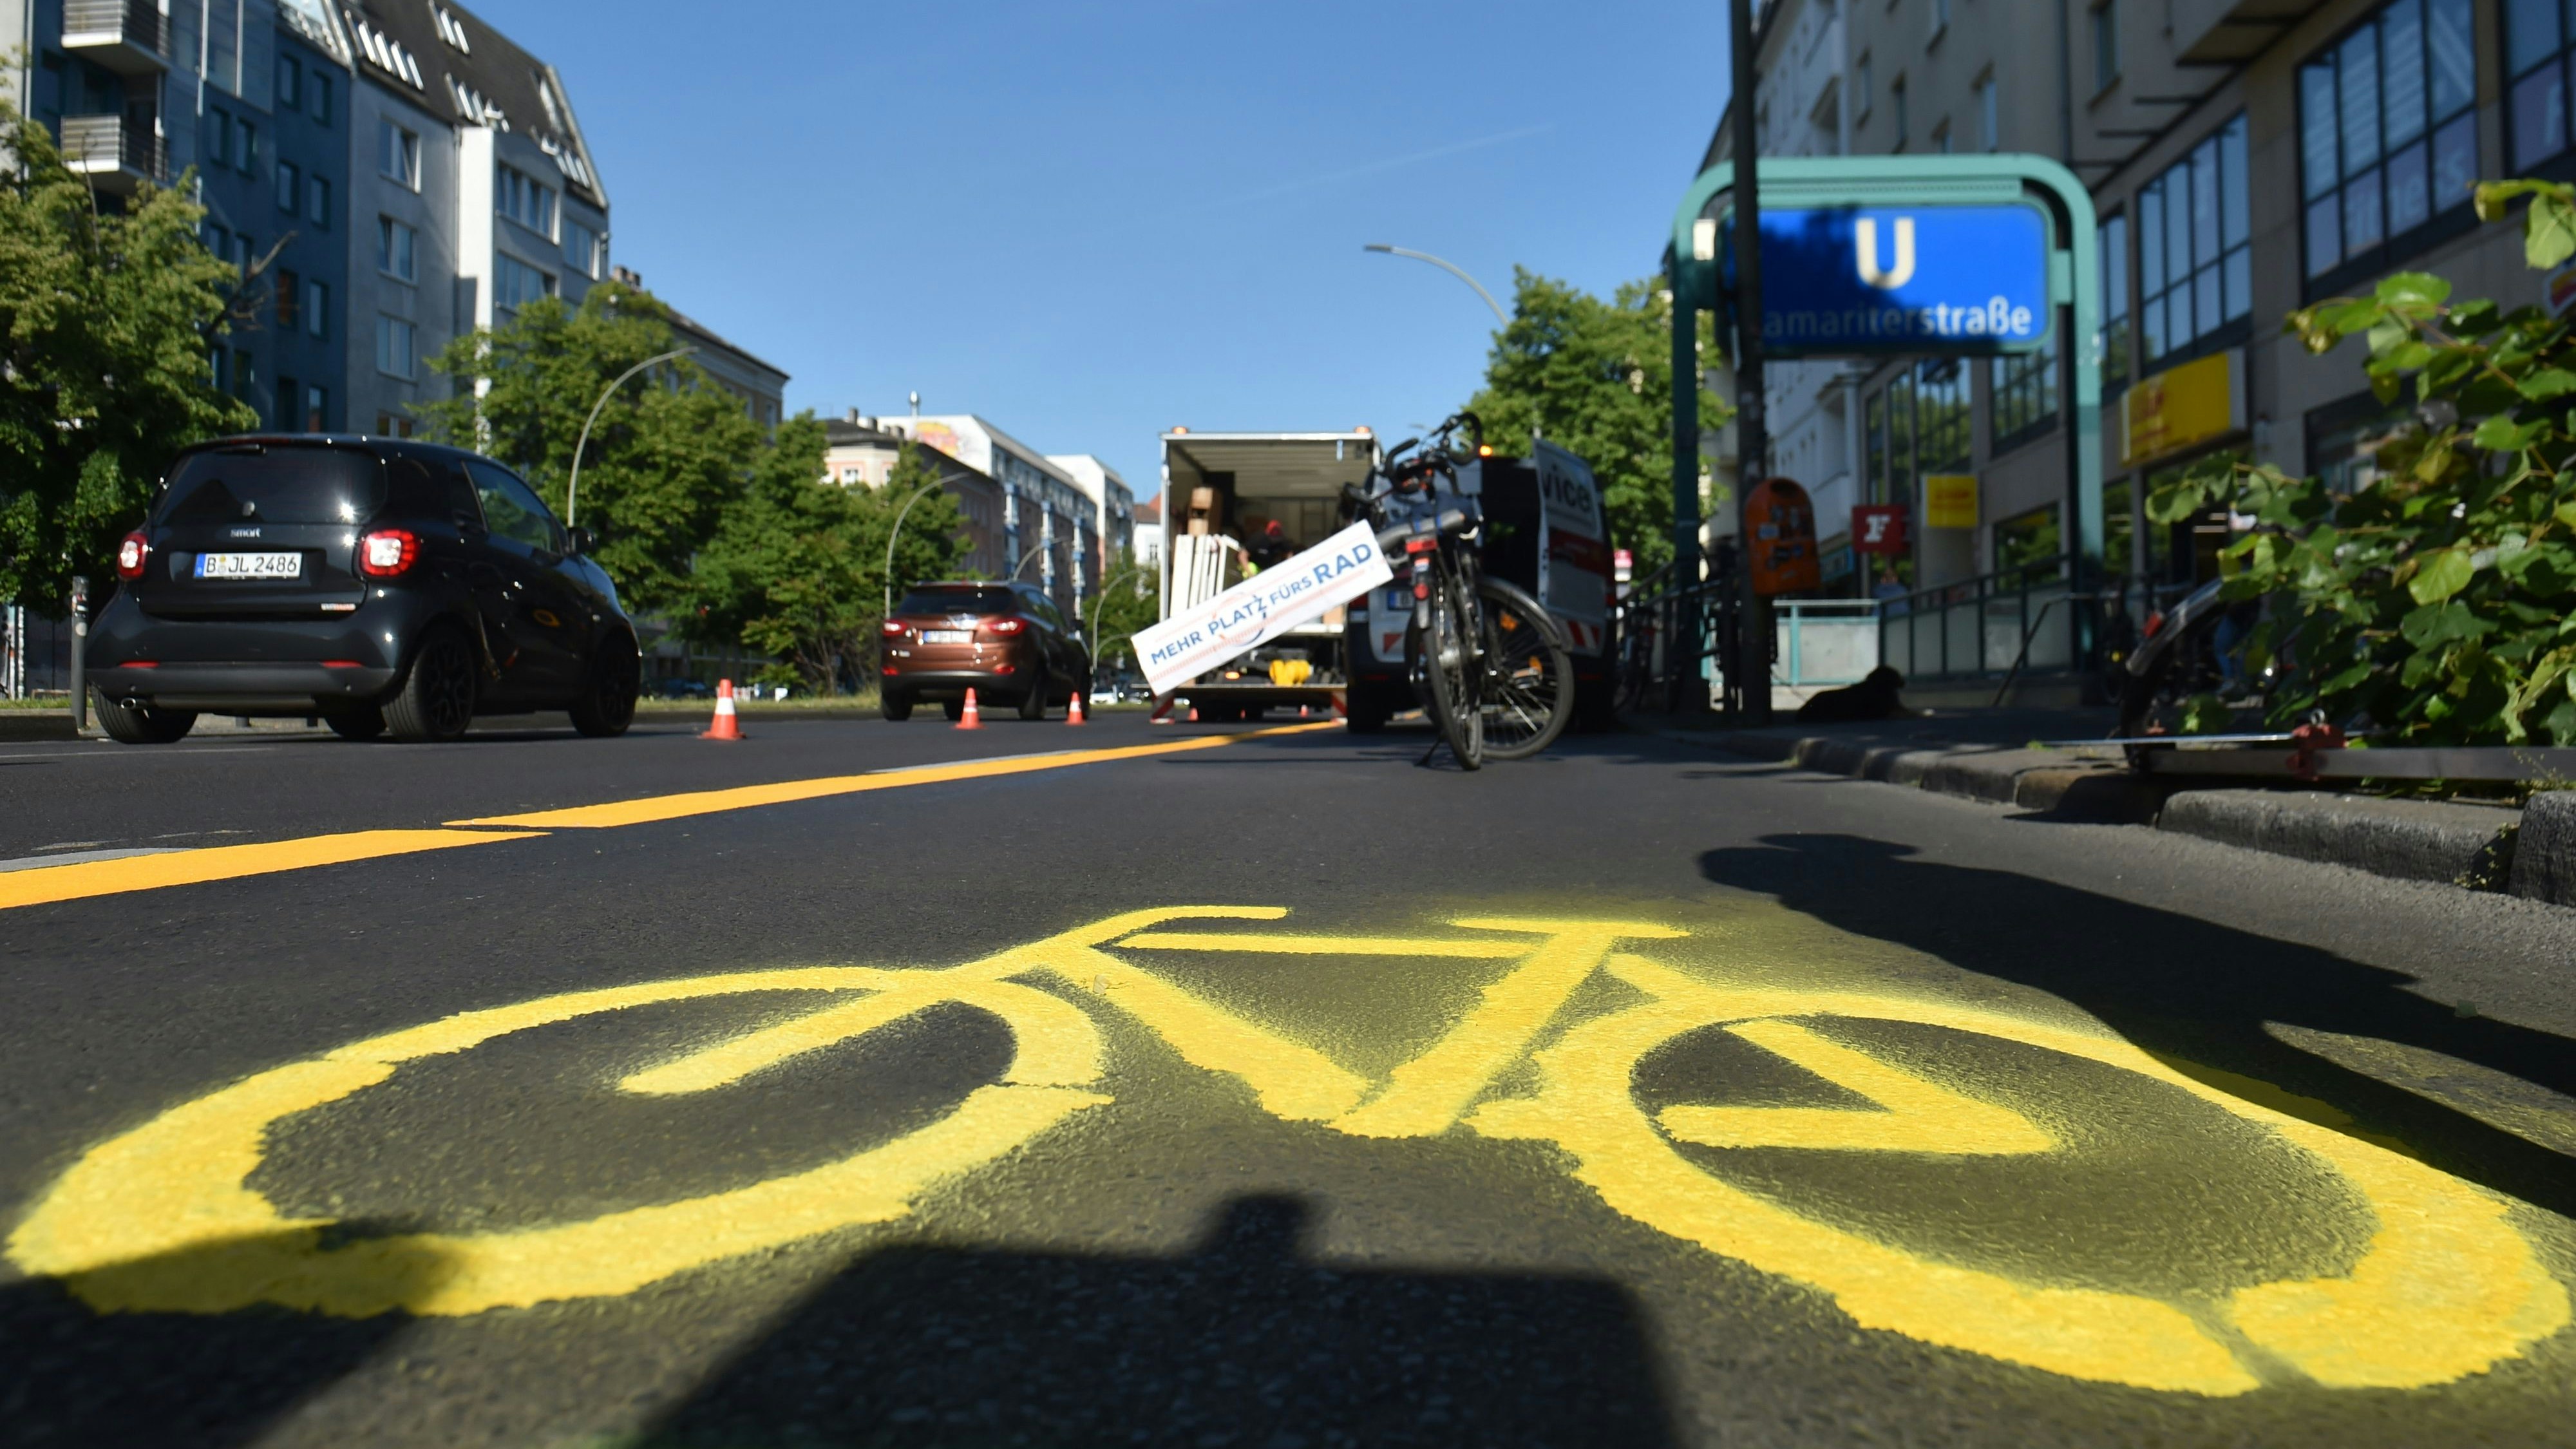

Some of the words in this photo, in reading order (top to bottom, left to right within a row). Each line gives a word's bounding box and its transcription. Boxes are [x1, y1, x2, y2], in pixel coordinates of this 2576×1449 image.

[1855, 216, 1915, 289] U
[1763, 295, 2032, 338] amariterstraße
[231, 527, 261, 538] smart
[205, 556, 216, 573] B
[228, 556, 249, 573] JL
[254, 556, 297, 573] 2486
[1150, 630, 1203, 665] MEHR
[1208, 596, 1267, 636] PLATZ
[1269, 578, 1312, 606] FÜRS
[1313, 543, 1372, 585] RAD
